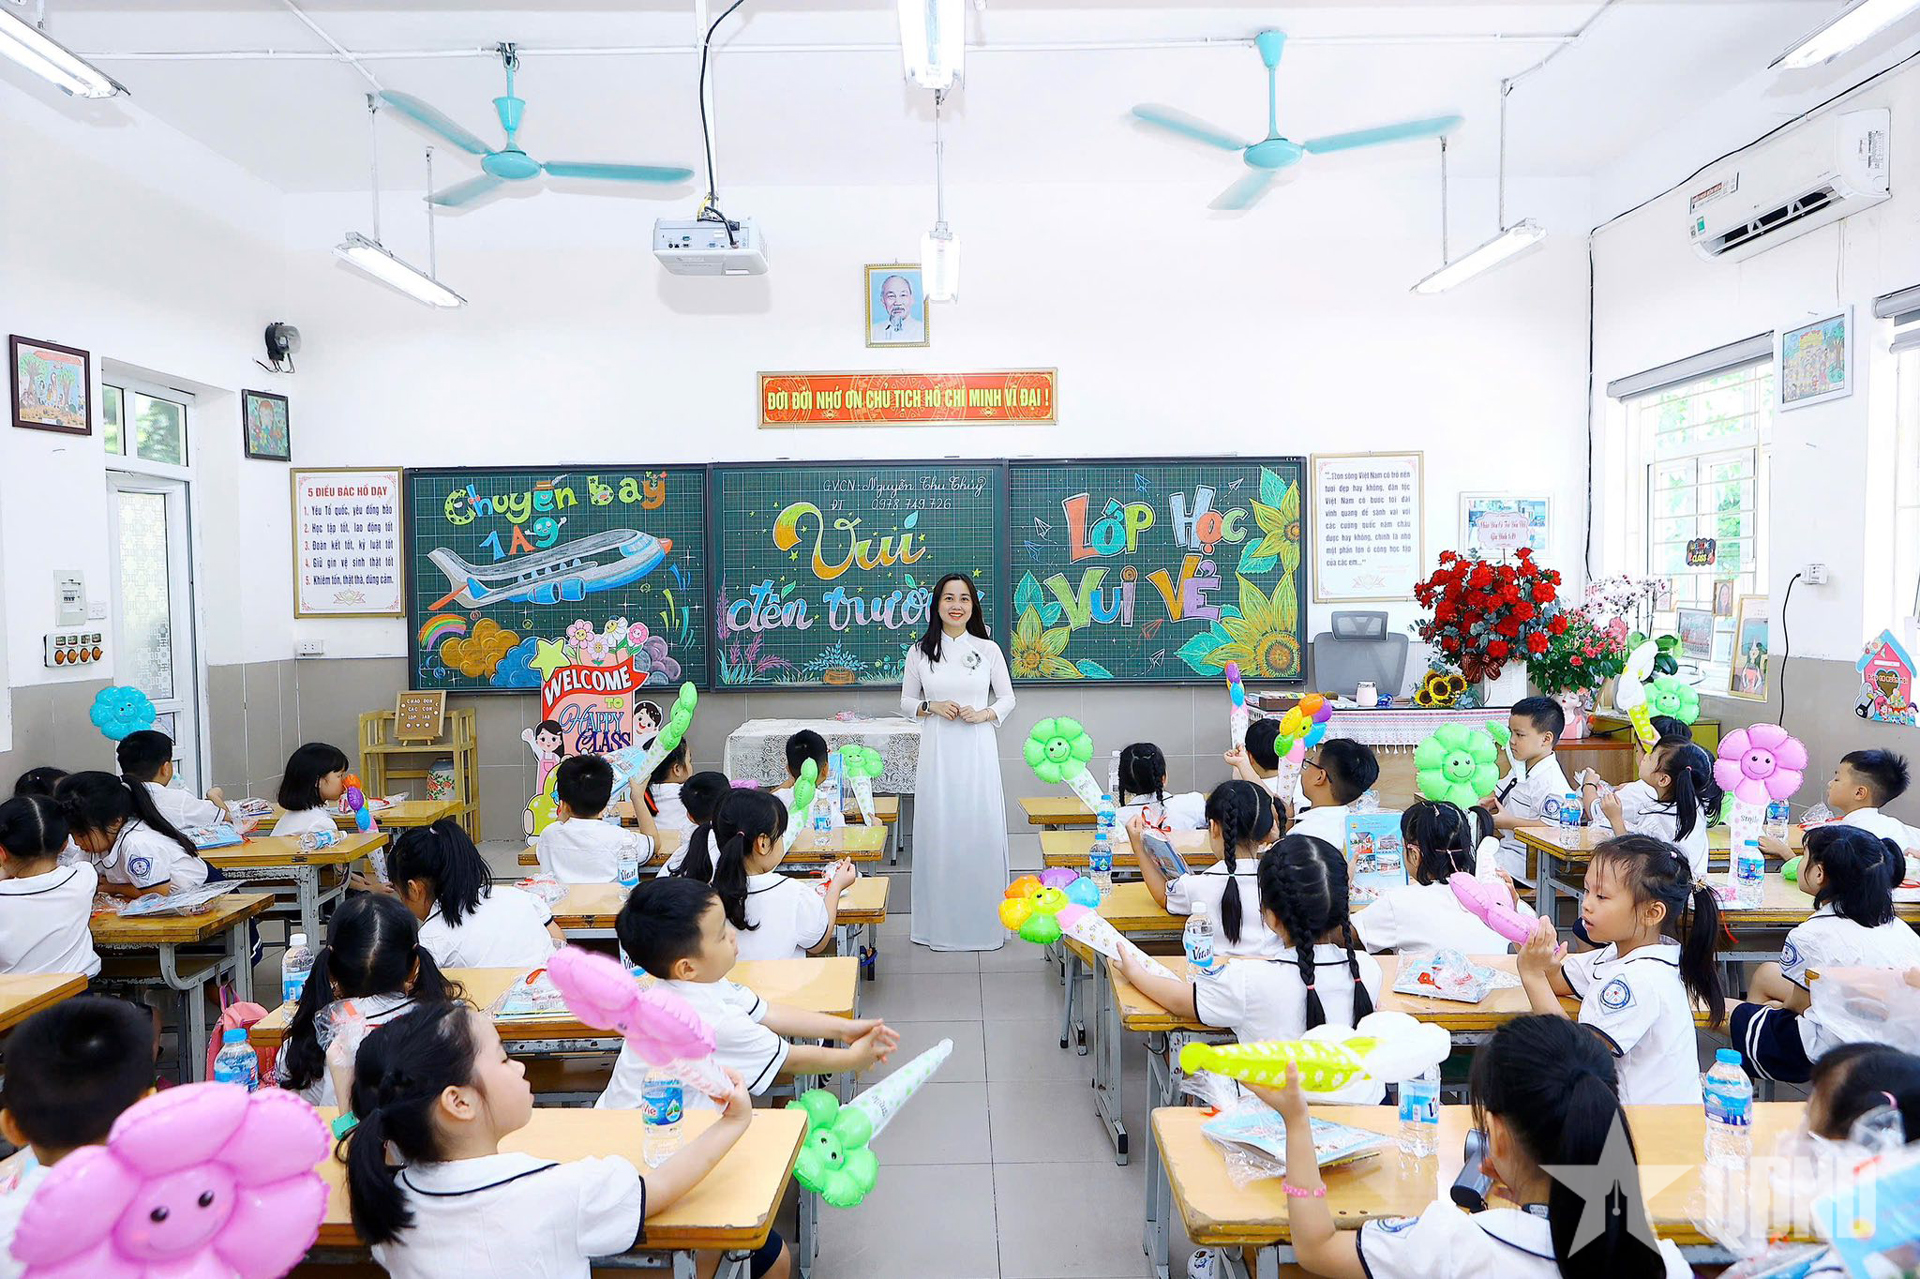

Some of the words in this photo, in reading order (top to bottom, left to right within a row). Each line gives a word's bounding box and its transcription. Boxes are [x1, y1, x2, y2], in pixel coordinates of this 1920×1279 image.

[816, 385, 842, 409] NHỚ
[865, 383, 890, 408] CHỦ
[944, 383, 966, 407] CHÍ
[969, 387, 1002, 407] MINH
[1019, 387, 1041, 410] ĐẠI
[307, 487, 313, 497] 5
[338, 484, 355, 497] BÁC
[371, 486, 388, 499] DẠY
[587, 471, 667, 510] bay
[919, 475, 945, 491] Thu
[773, 502, 926, 580] Vui
[727, 579, 814, 633] đến
[544, 666, 632, 708] WELCOME
[604, 697, 625, 710] TO
